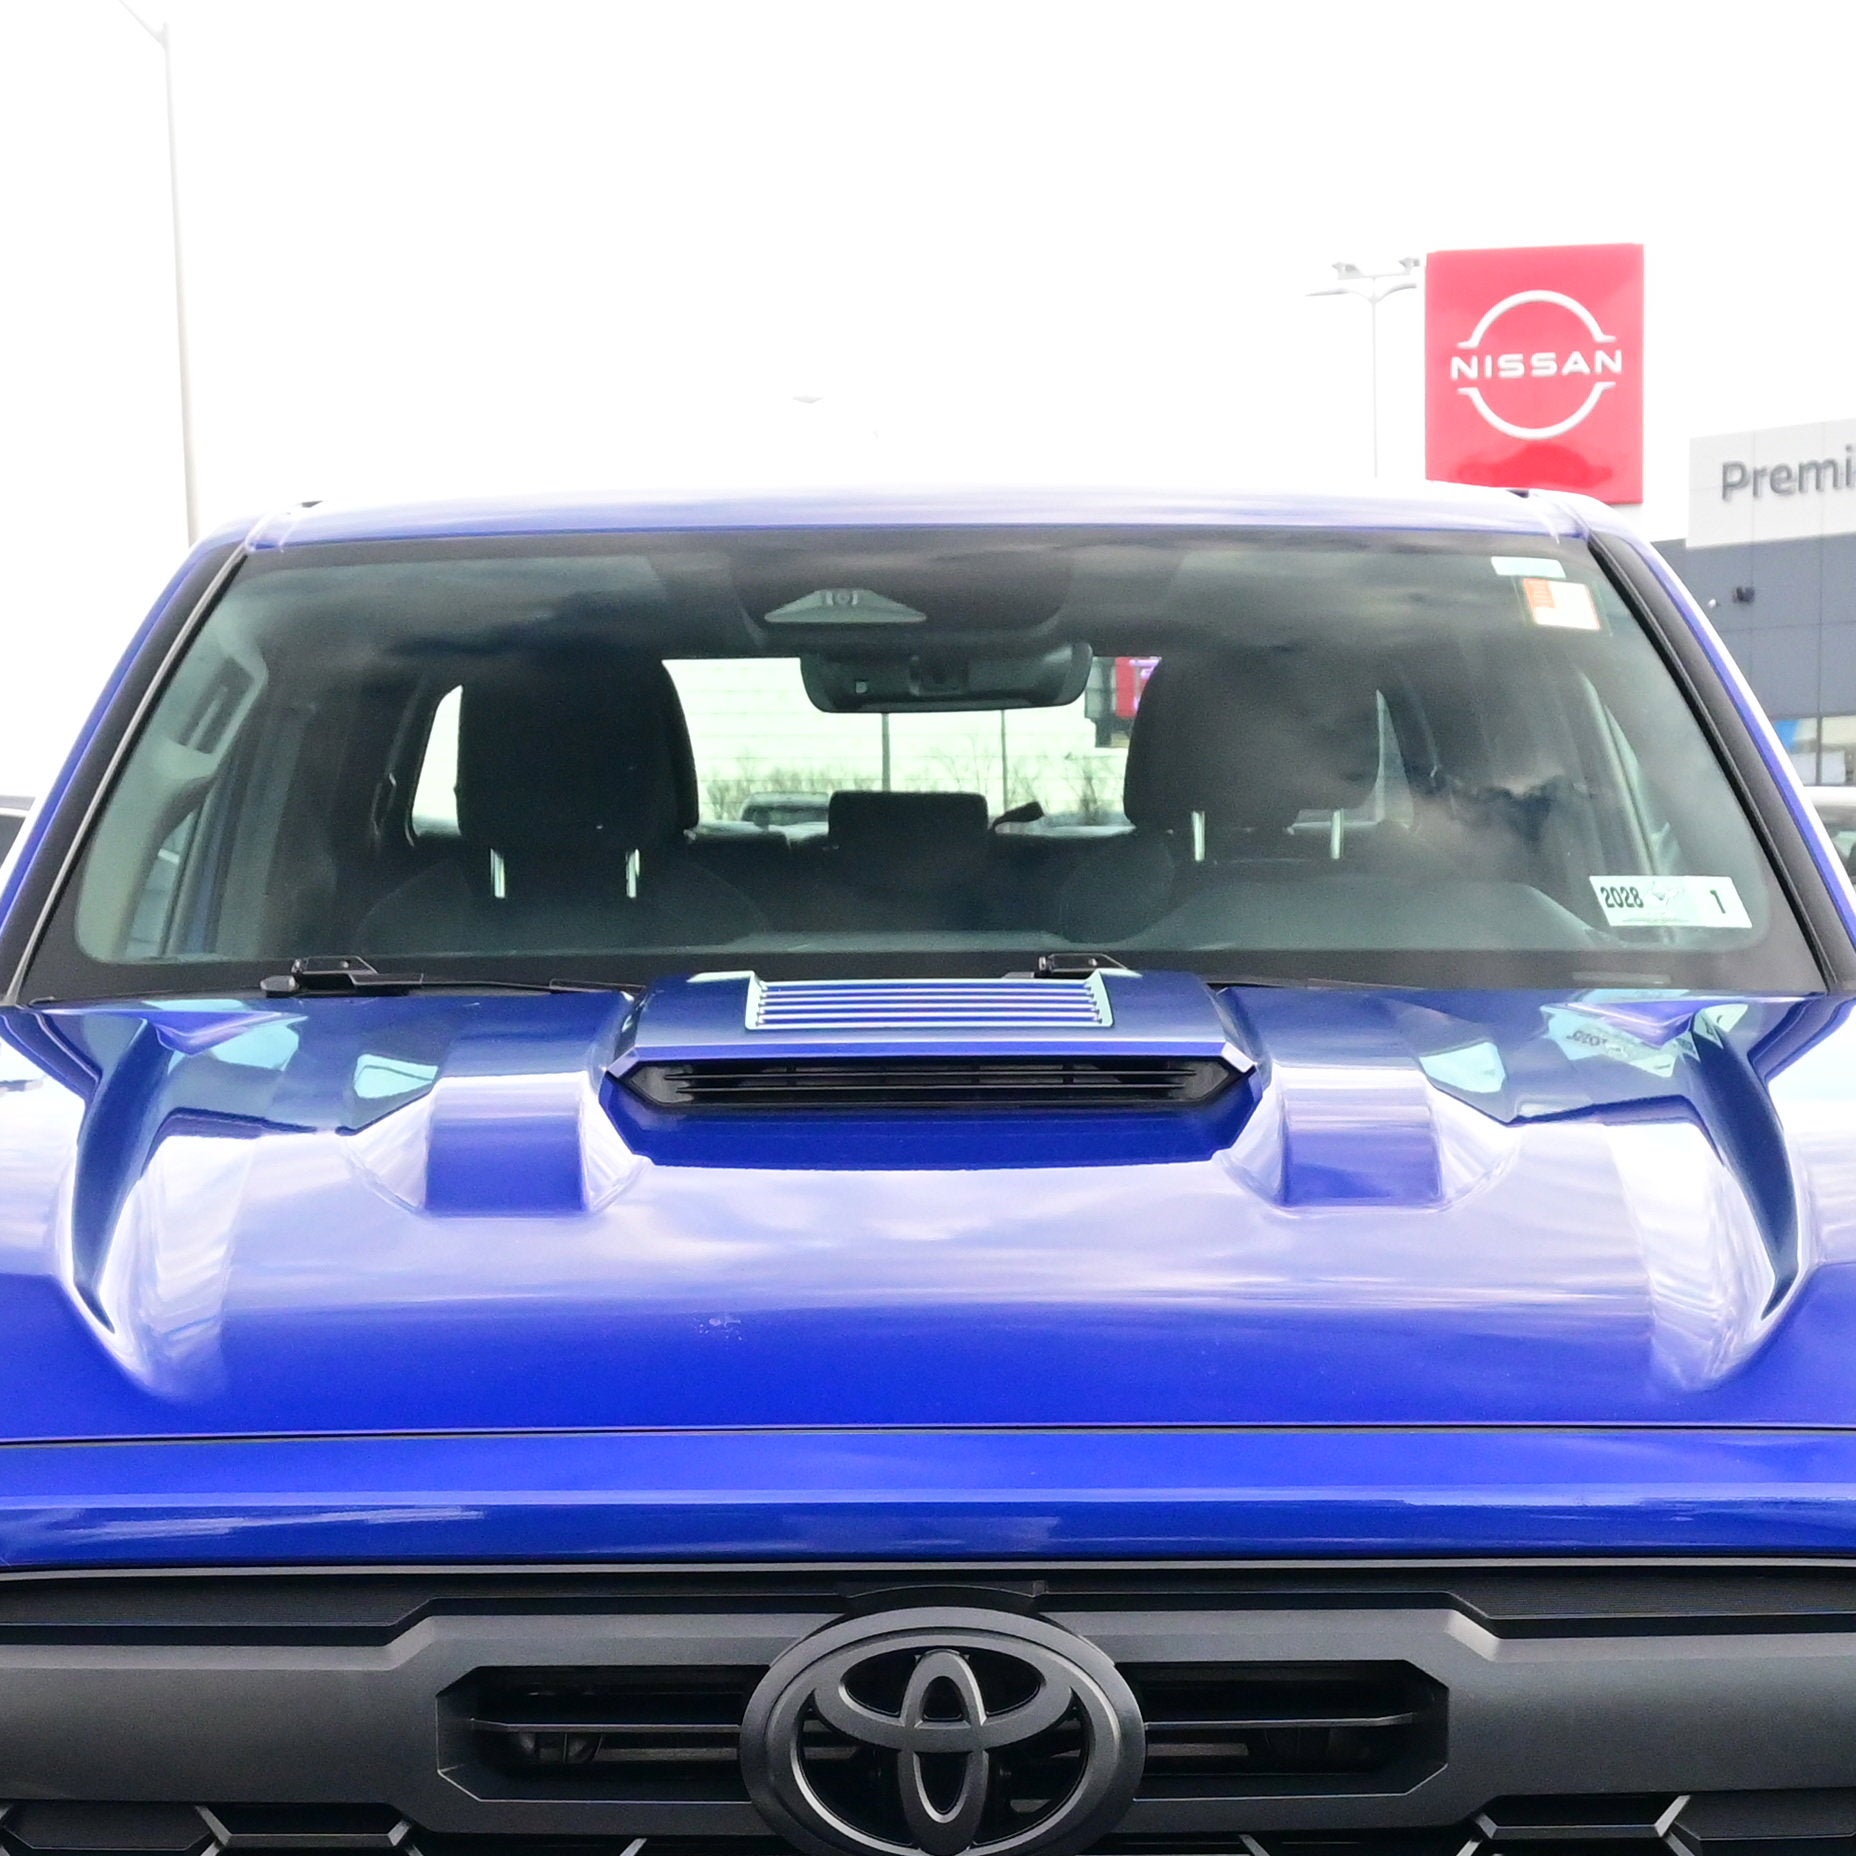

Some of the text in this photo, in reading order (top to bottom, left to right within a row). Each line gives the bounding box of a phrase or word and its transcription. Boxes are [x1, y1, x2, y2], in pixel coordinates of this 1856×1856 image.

[1449, 349, 1624, 381] NISSAN
[1600, 886, 1726, 914] 2028 1
